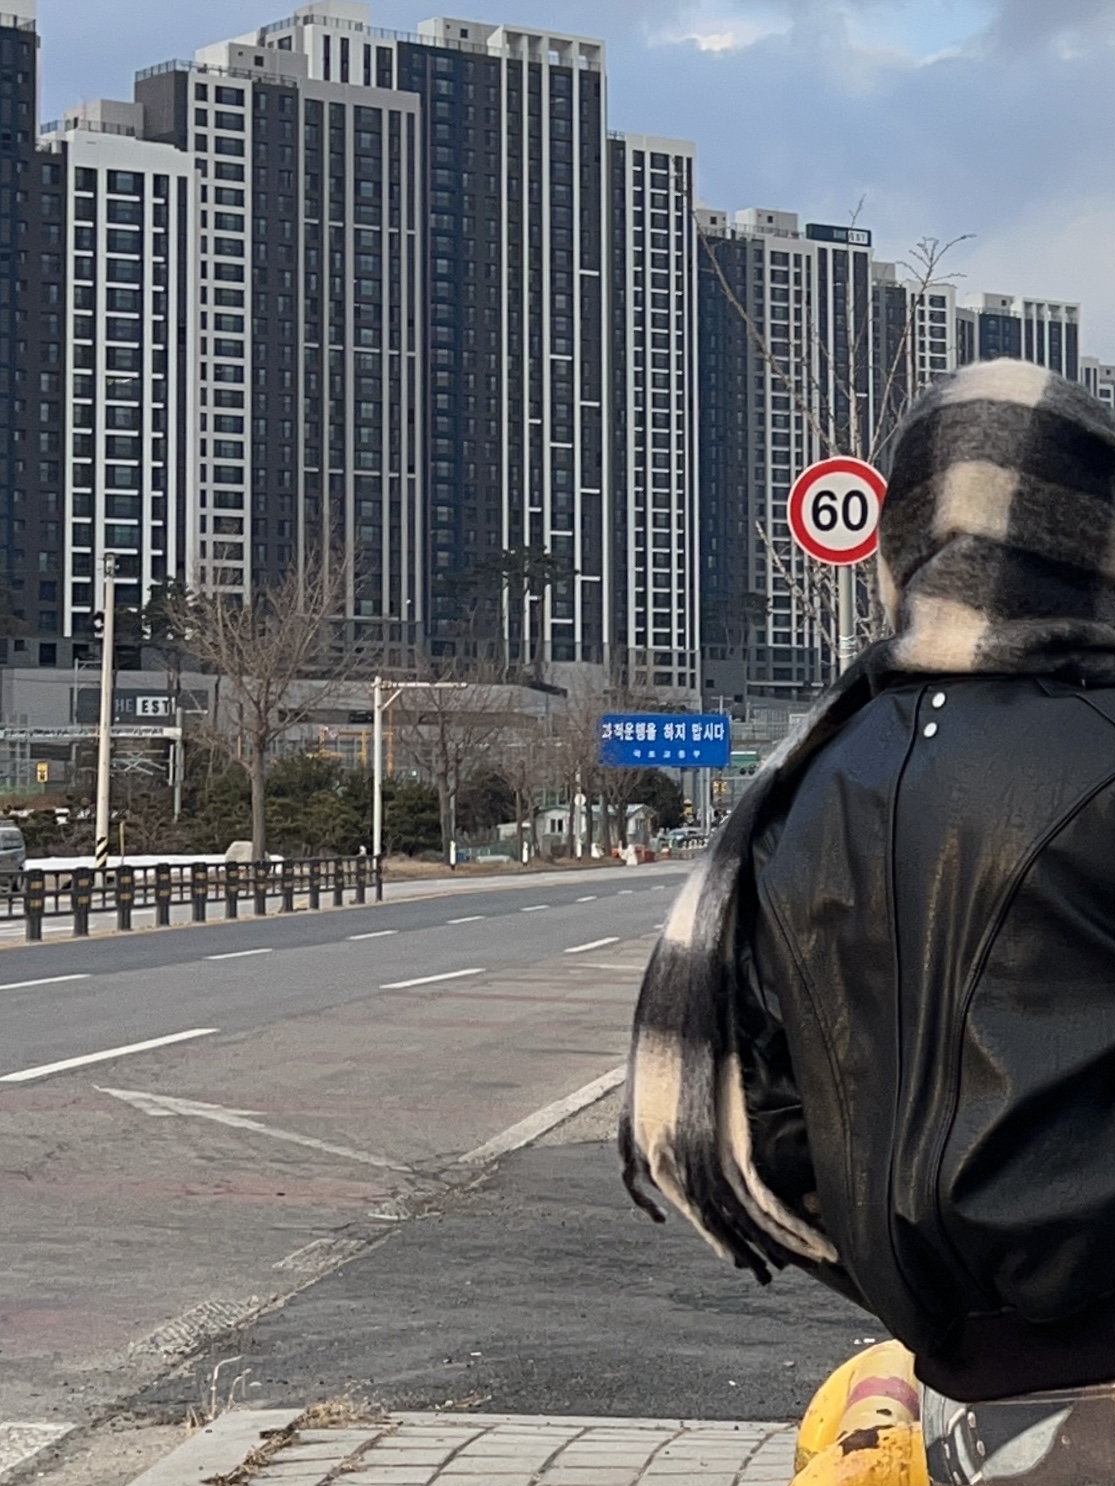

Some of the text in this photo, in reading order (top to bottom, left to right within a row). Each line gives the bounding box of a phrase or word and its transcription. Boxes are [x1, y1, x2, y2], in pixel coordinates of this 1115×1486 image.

[812, 489, 868, 531] 60
[141, 699, 170, 714] EST
[602, 722, 725, 741] 과적운행을 하지 맙시다
